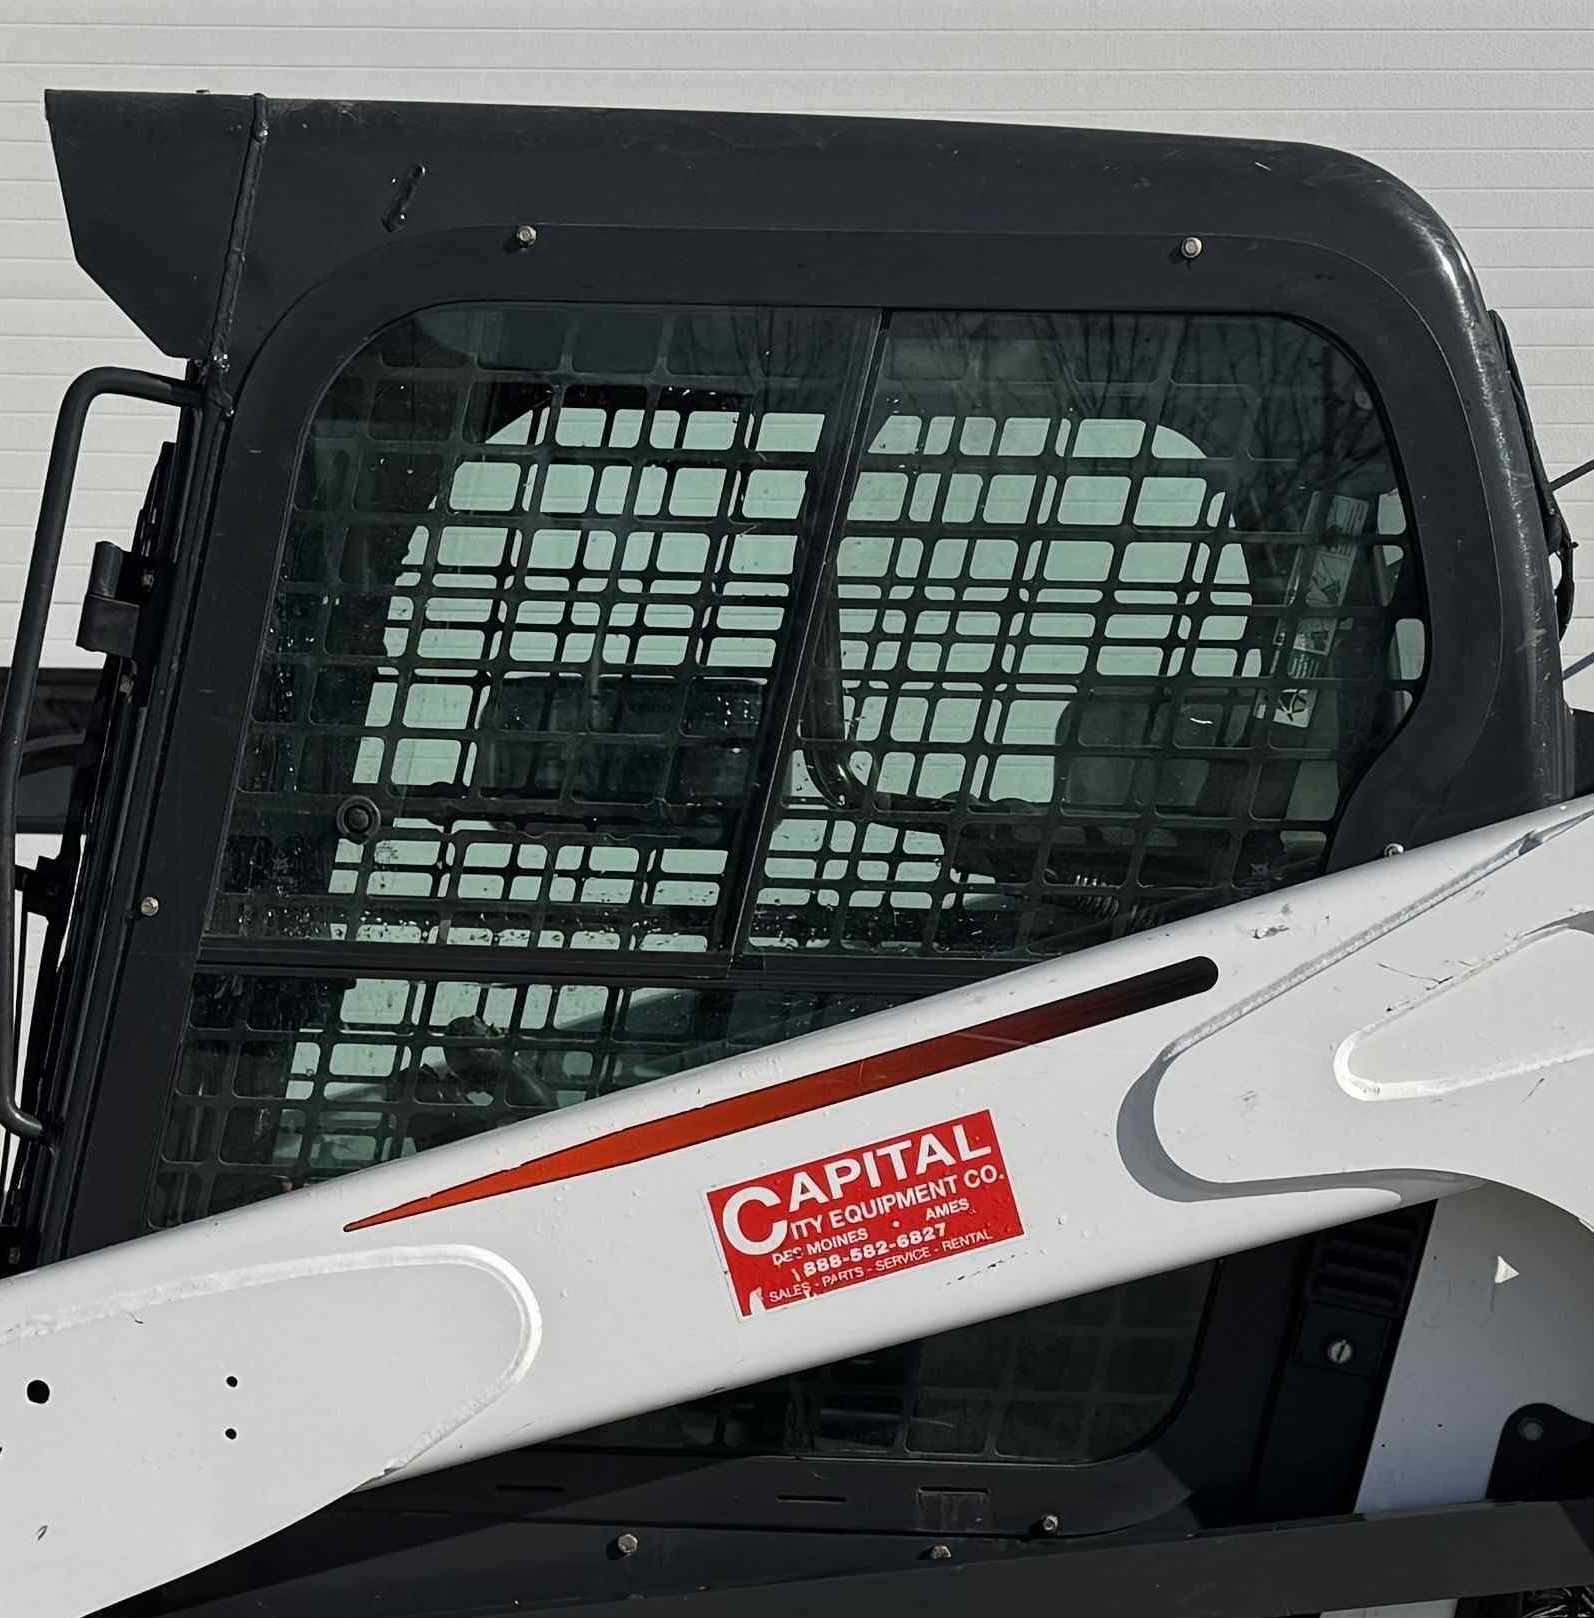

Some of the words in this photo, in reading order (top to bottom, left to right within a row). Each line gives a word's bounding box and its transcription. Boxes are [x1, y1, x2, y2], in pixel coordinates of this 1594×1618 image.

[721, 1124, 992, 1256] CAPITAL
[830, 1174, 958, 1230] EQUIPMENT
[962, 1164, 1006, 1190] CO.
[807, 1227, 869, 1257] MOINES
[925, 1197, 971, 1222] AMES
[768, 1279, 812, 1303] SALES
[822, 1266, 865, 1288] PARTS
[874, 1246, 932, 1273] SERVICE
[941, 1228, 994, 1252] RENTAL
